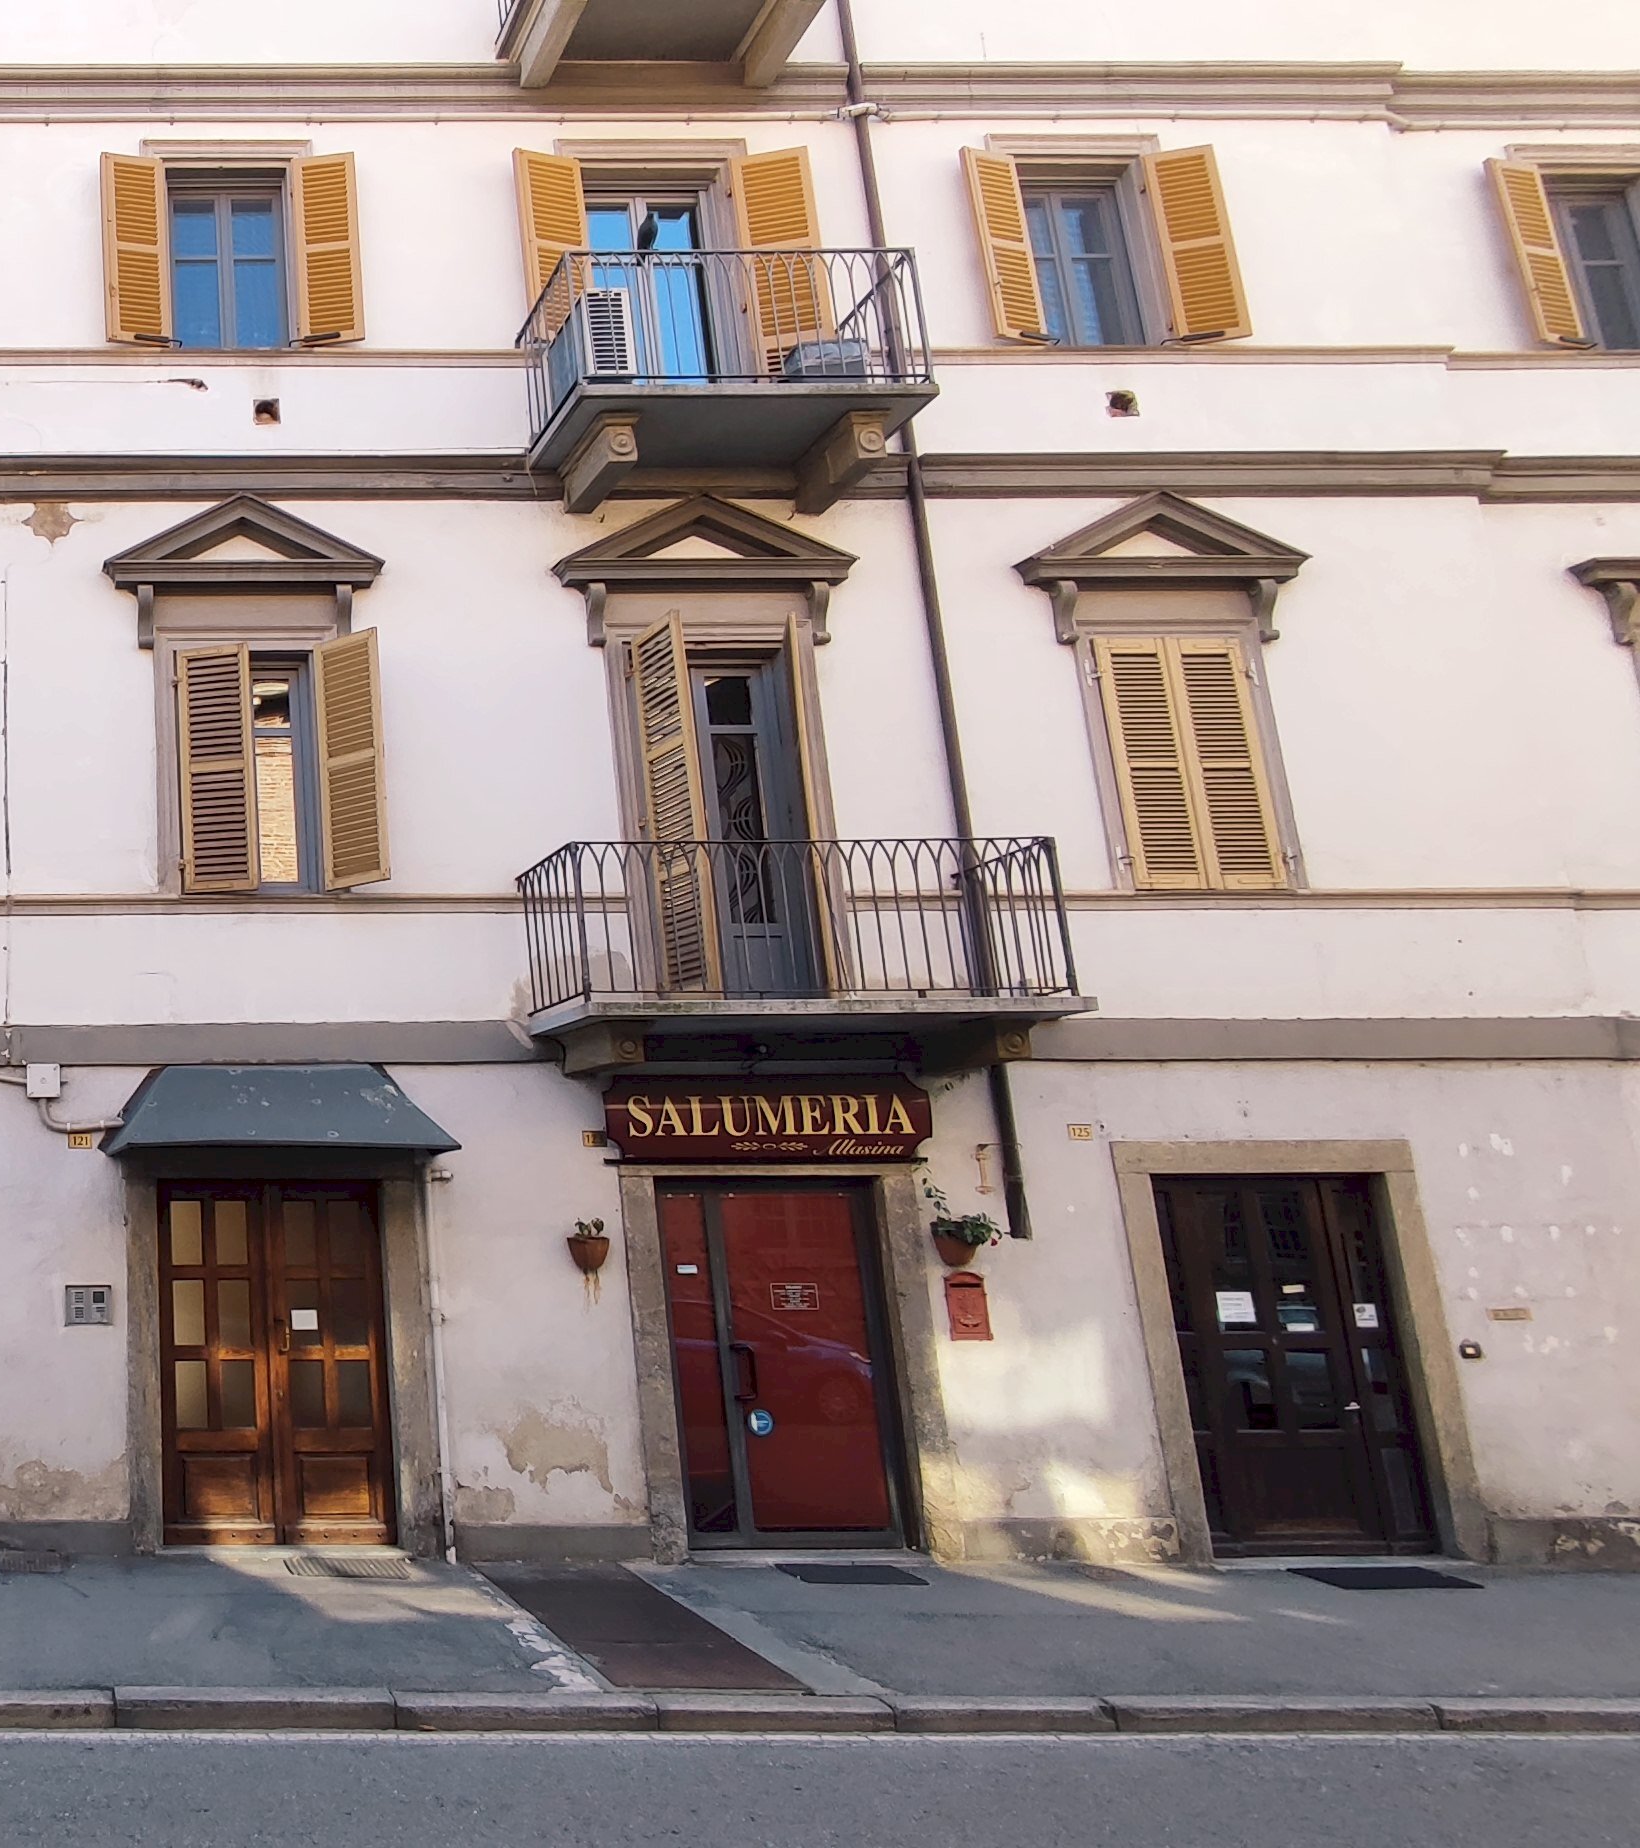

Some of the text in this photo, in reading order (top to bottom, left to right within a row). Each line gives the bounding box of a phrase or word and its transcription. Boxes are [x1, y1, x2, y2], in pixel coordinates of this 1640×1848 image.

[626, 1093, 916, 1138] SALUMERIA
[1072, 1127, 1090, 1137] 125
[73, 1135, 88, 1146] 121
[813, 1138, 905, 1156] Allasina
